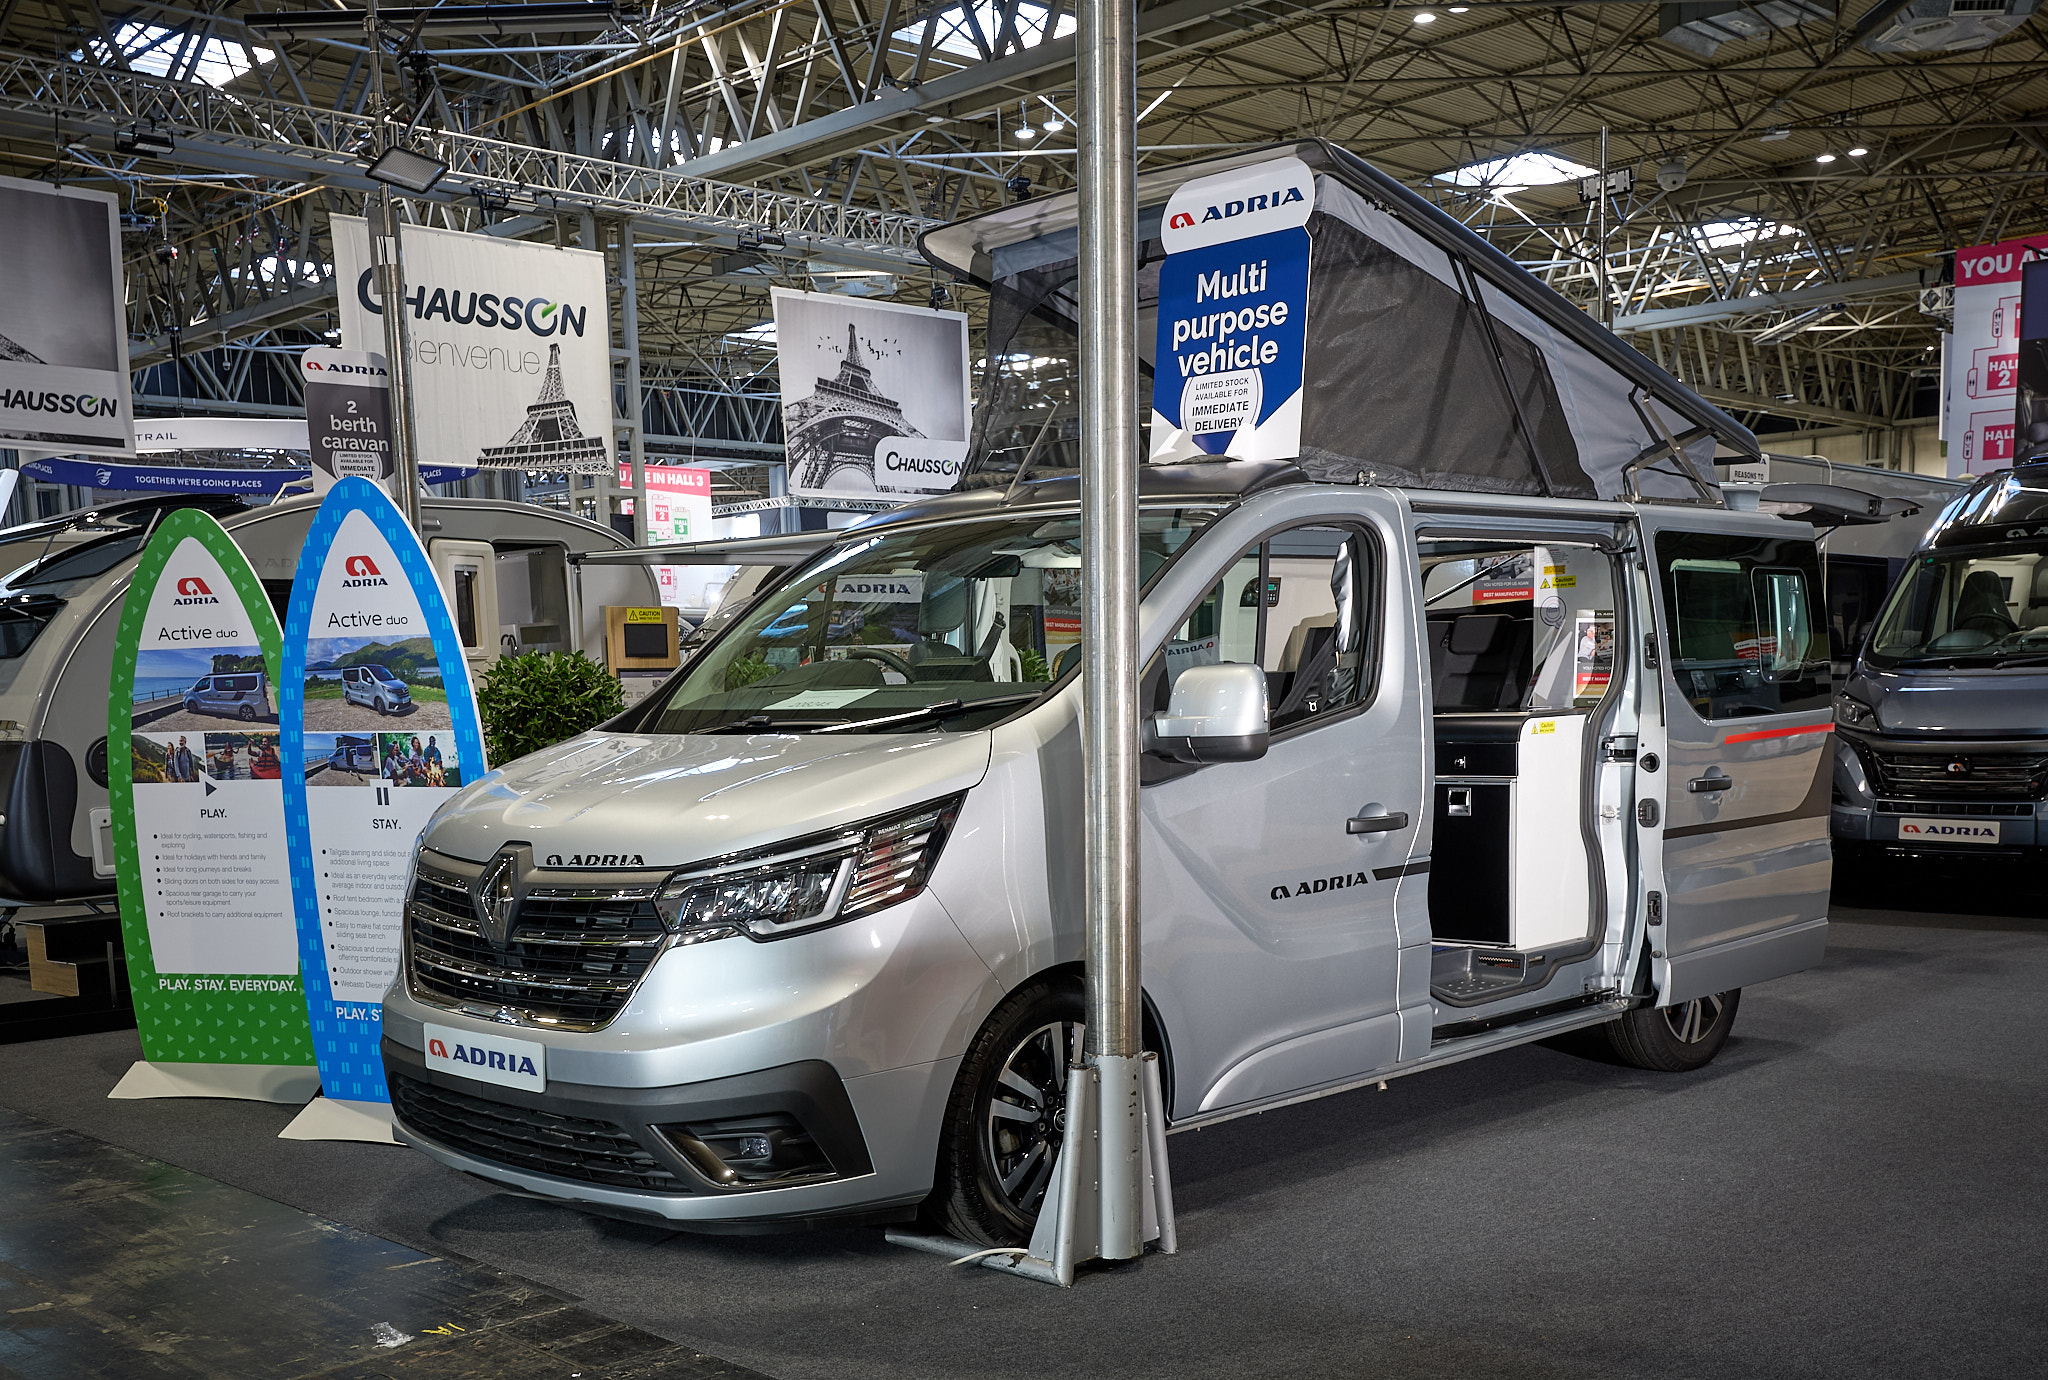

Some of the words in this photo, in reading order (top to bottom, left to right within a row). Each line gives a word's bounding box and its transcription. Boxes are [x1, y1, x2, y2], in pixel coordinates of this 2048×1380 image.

[1201, 186, 1305, 224] ADRIA
[1961, 253, 2013, 279] YOU
[1196, 259, 1268, 303] Multi
[1172, 301, 1289, 351] purpose
[1178, 334, 1279, 377] vehicle
[327, 363, 388, 376] ADRIA
[1195, 381, 1224, 391] LIMITED
[1225, 377, 1250, 387] STOCK
[1998, 370, 2011, 387] 2
[1195, 392, 1232, 402] AVAILABLE
[1234, 388, 1249, 397] FOR
[0, 388, 118, 418] HAUSSON
[346, 400, 358, 414] 2
[1192, 401, 1250, 417] IMMEDIATE
[330, 414, 377, 434] berth
[1195, 416, 1244, 432] DELIVERY
[135, 432, 178, 441] TRAIL
[321, 435, 389, 452] caravan
[1996, 440, 2005, 456] 1
[423, 469, 442, 479] PLACES
[652, 472, 666, 485] IN
[667, 473, 695, 487] HALL
[696, 475, 704, 487] 3
[1734, 470, 1757, 480] REASONS
[1757, 473, 1765, 481] TO
[135, 476, 176, 485] TOGETHER
[177, 478, 201, 486] WE'RE
[202, 479, 230, 487] GOING
[231, 480, 262, 488] PLACES
[679, 525, 685, 534] 3
[341, 578, 388, 588] ADRIA
[841, 584, 911, 595] ADRIA
[173, 597, 219, 606] ADRIA
[328, 612, 382, 628] Active
[386, 616, 408, 625] duo
[158, 626, 212, 641] Active
[216, 630, 238, 638] duo
[200, 808, 227, 818] PLAY.
[372, 818, 402, 830] STAY.
[238, 832, 255, 840] fishing
[1925, 826, 1995, 837] ADRIA
[184, 853, 206, 861] holidays
[251, 852, 266, 861] family
[350, 850, 371, 858] awning
[373, 860, 390, 868] space
[568, 855, 645, 866] ADRIA
[185, 865, 197, 874] long
[198, 866, 220, 874] journeys
[164, 877, 182, 885] Sliding
[245, 877, 258, 885] easy
[362, 873, 387, 882] everyday
[332, 882, 354, 890] average
[1296, 872, 1369, 897] ADRIA
[165, 889, 190, 897] Spacious
[202, 890, 222, 898] garage
[229, 889, 243, 898] carry
[244, 889, 256, 898] your
[333, 894, 346, 902] Roof
[181, 910, 204, 918] brackets
[212, 910, 226, 919] carry
[226, 910, 253, 918] additional
[253, 910, 283, 919] equipment
[334, 907, 360, 917] Spacious
[335, 921, 349, 930] Easy
[368, 932, 386, 940] bench
[337, 943, 363, 954] Spacious
[363, 945, 375, 953] and
[359, 955, 393, 963] comfortable
[339, 966, 362, 975] Outdoor
[362, 968, 383, 976] shower
[159, 978, 192, 991] PLAY.
[194, 979, 227, 991] STAY.
[229, 980, 297, 992] EVERYDAY.
[340, 979, 365, 988] Webasto
[365, 981, 383, 989] Diesel
[335, 1006, 369, 1021] PLAY.
[453, 1043, 538, 1077] ADRIA
